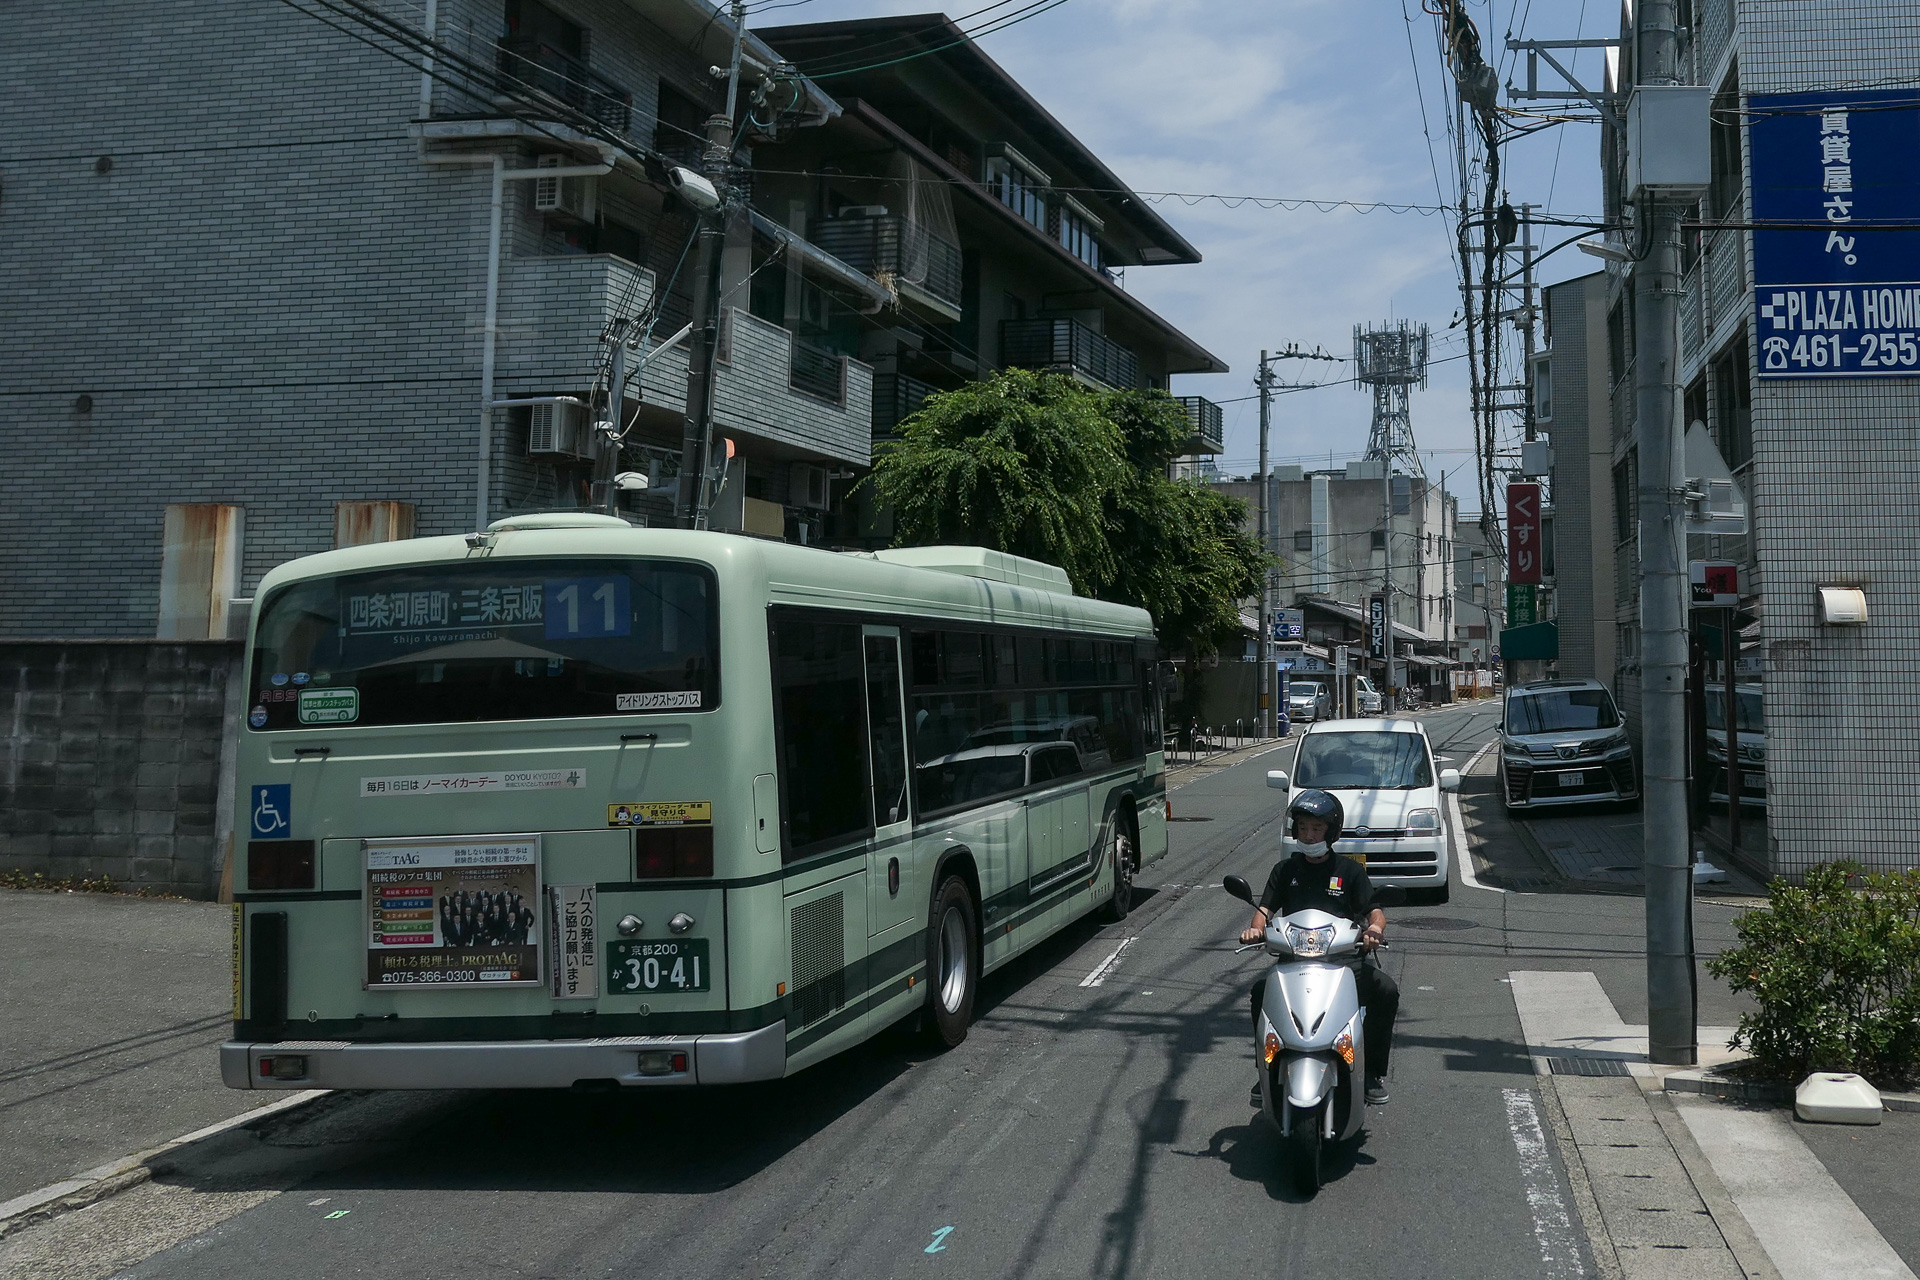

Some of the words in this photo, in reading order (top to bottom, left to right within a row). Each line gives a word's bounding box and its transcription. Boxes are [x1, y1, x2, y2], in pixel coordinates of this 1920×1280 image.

[1787, 290, 1858, 331] PLAZA
[1791, 333, 1920, 368] 461-255
[1513, 496, 1535, 573] くすり
[1694, 586, 1712, 594] You
[350, 585, 543, 628] 四条河原町・三条京阪
[556, 583, 615, 633] 11
[1289, 625, 1301, 636] 空
[1371, 602, 1383, 655] SUZUKI
[393, 634, 420, 645] Shijo
[425, 630, 498, 642] Kawaramachi
[260, 689, 297, 703] ABS
[618, 693, 700, 708] アイドリングストップバス
[367, 779, 420, 793] 毎月16日は
[422, 777, 498, 790] ノーマイカーデー
[651, 809, 686, 817] 見守り中
[371, 871, 443, 883] 相続税のプロ集団
[580, 888, 594, 967] バスの発進に
[565, 901, 579, 995] ご協力願います
[392, 970, 476, 983] 075-366-0300
[612, 969, 623, 980] か
[625, 956, 700, 989] 30-41
